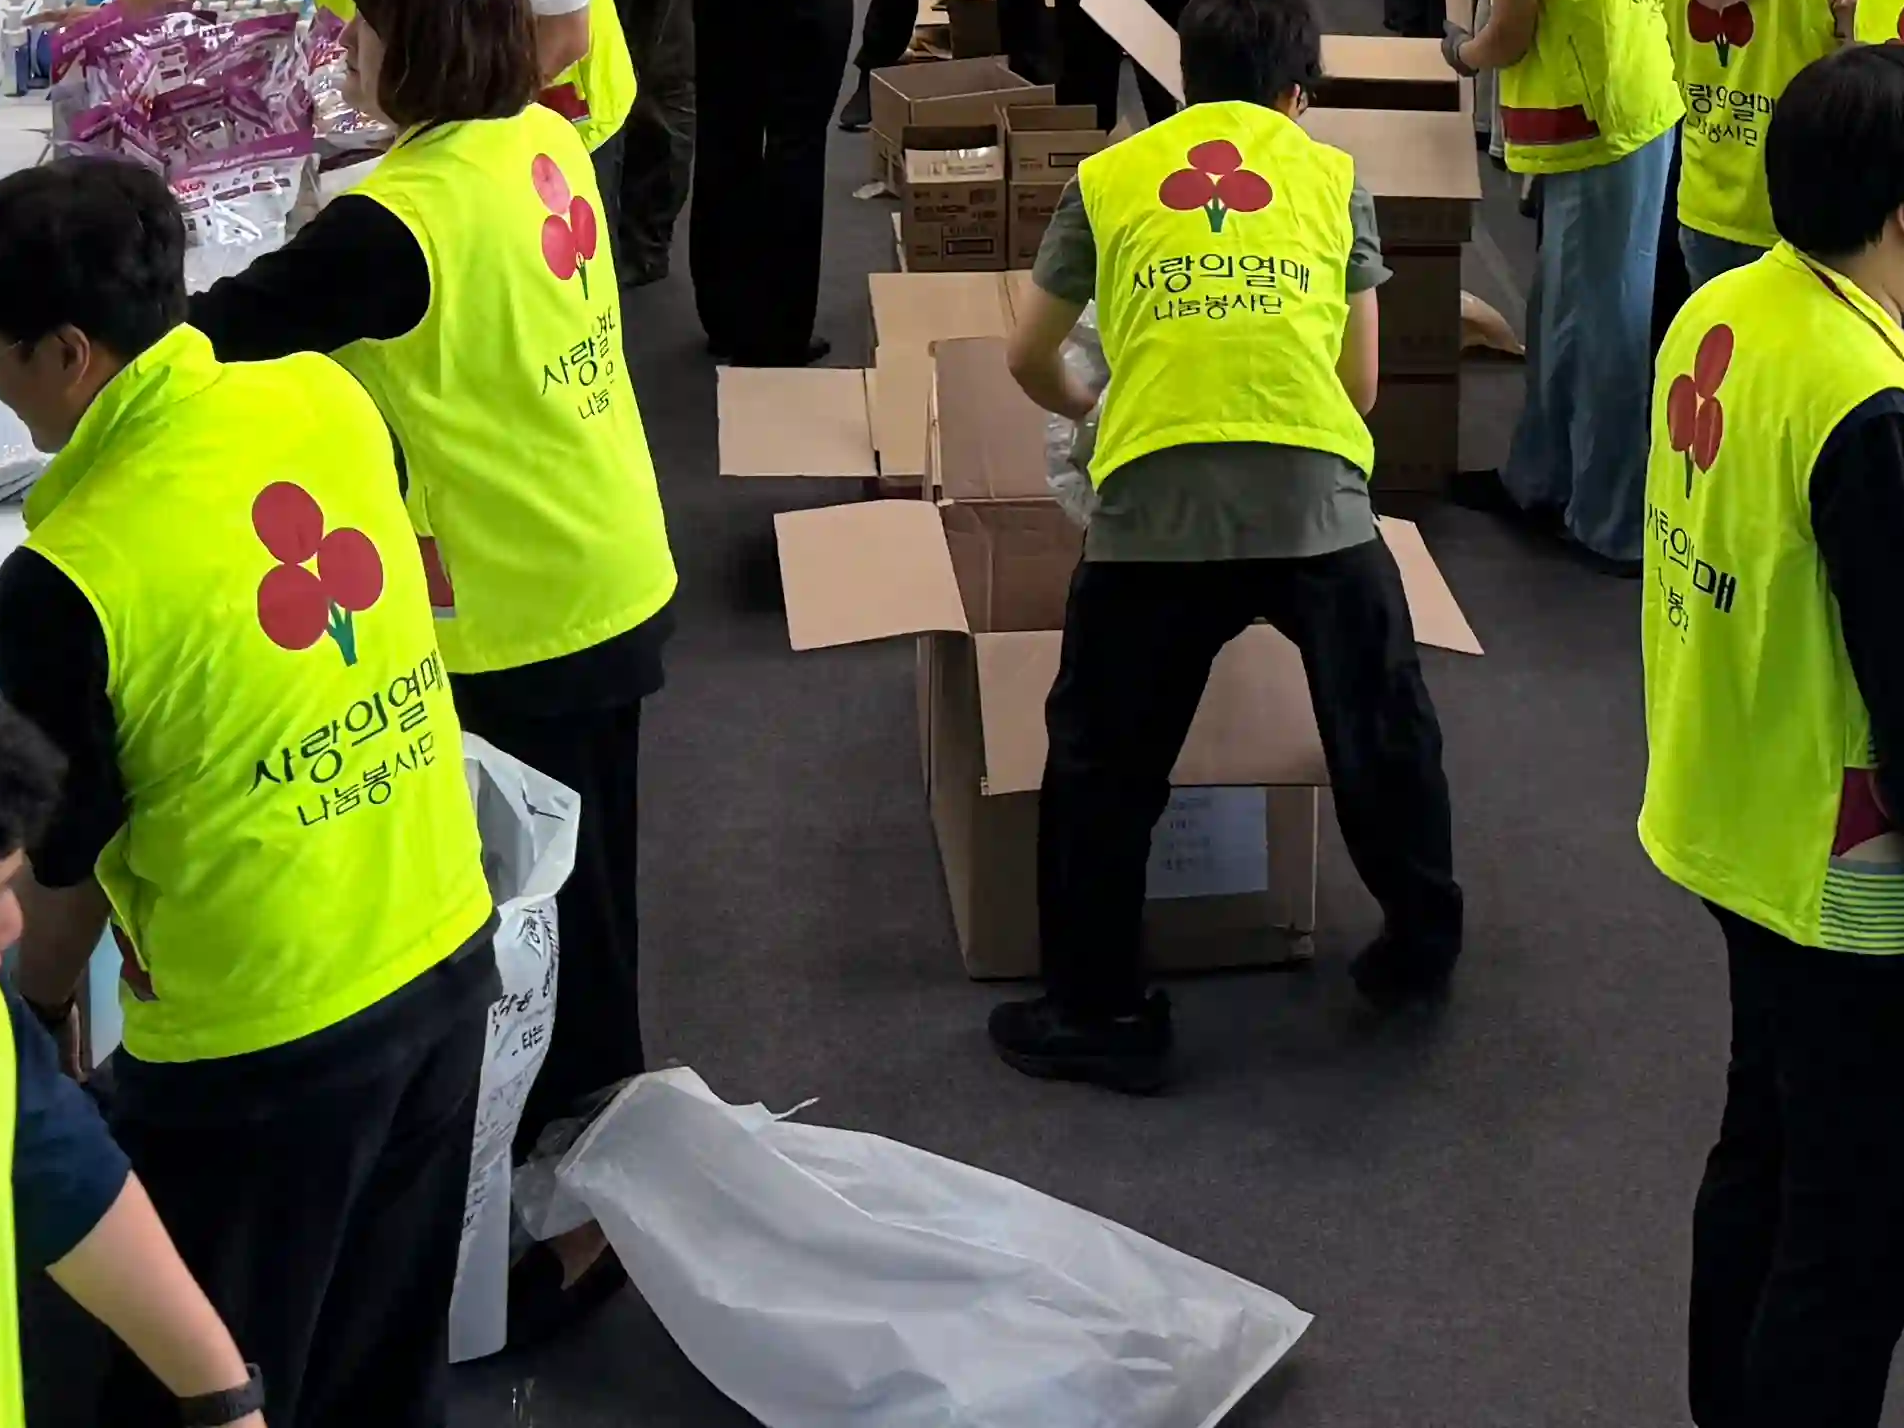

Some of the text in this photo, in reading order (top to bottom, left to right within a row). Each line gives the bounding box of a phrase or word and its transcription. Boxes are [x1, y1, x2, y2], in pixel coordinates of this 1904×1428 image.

[1686, 83, 1773, 123] 랑의열
[1131, 253, 1311, 294] 사랑의열매
[1153, 294, 1284, 321] 나눔봉사단
[245, 648, 446, 798] 사랑의열매
[296, 730, 437, 828] 나눔봉사단
